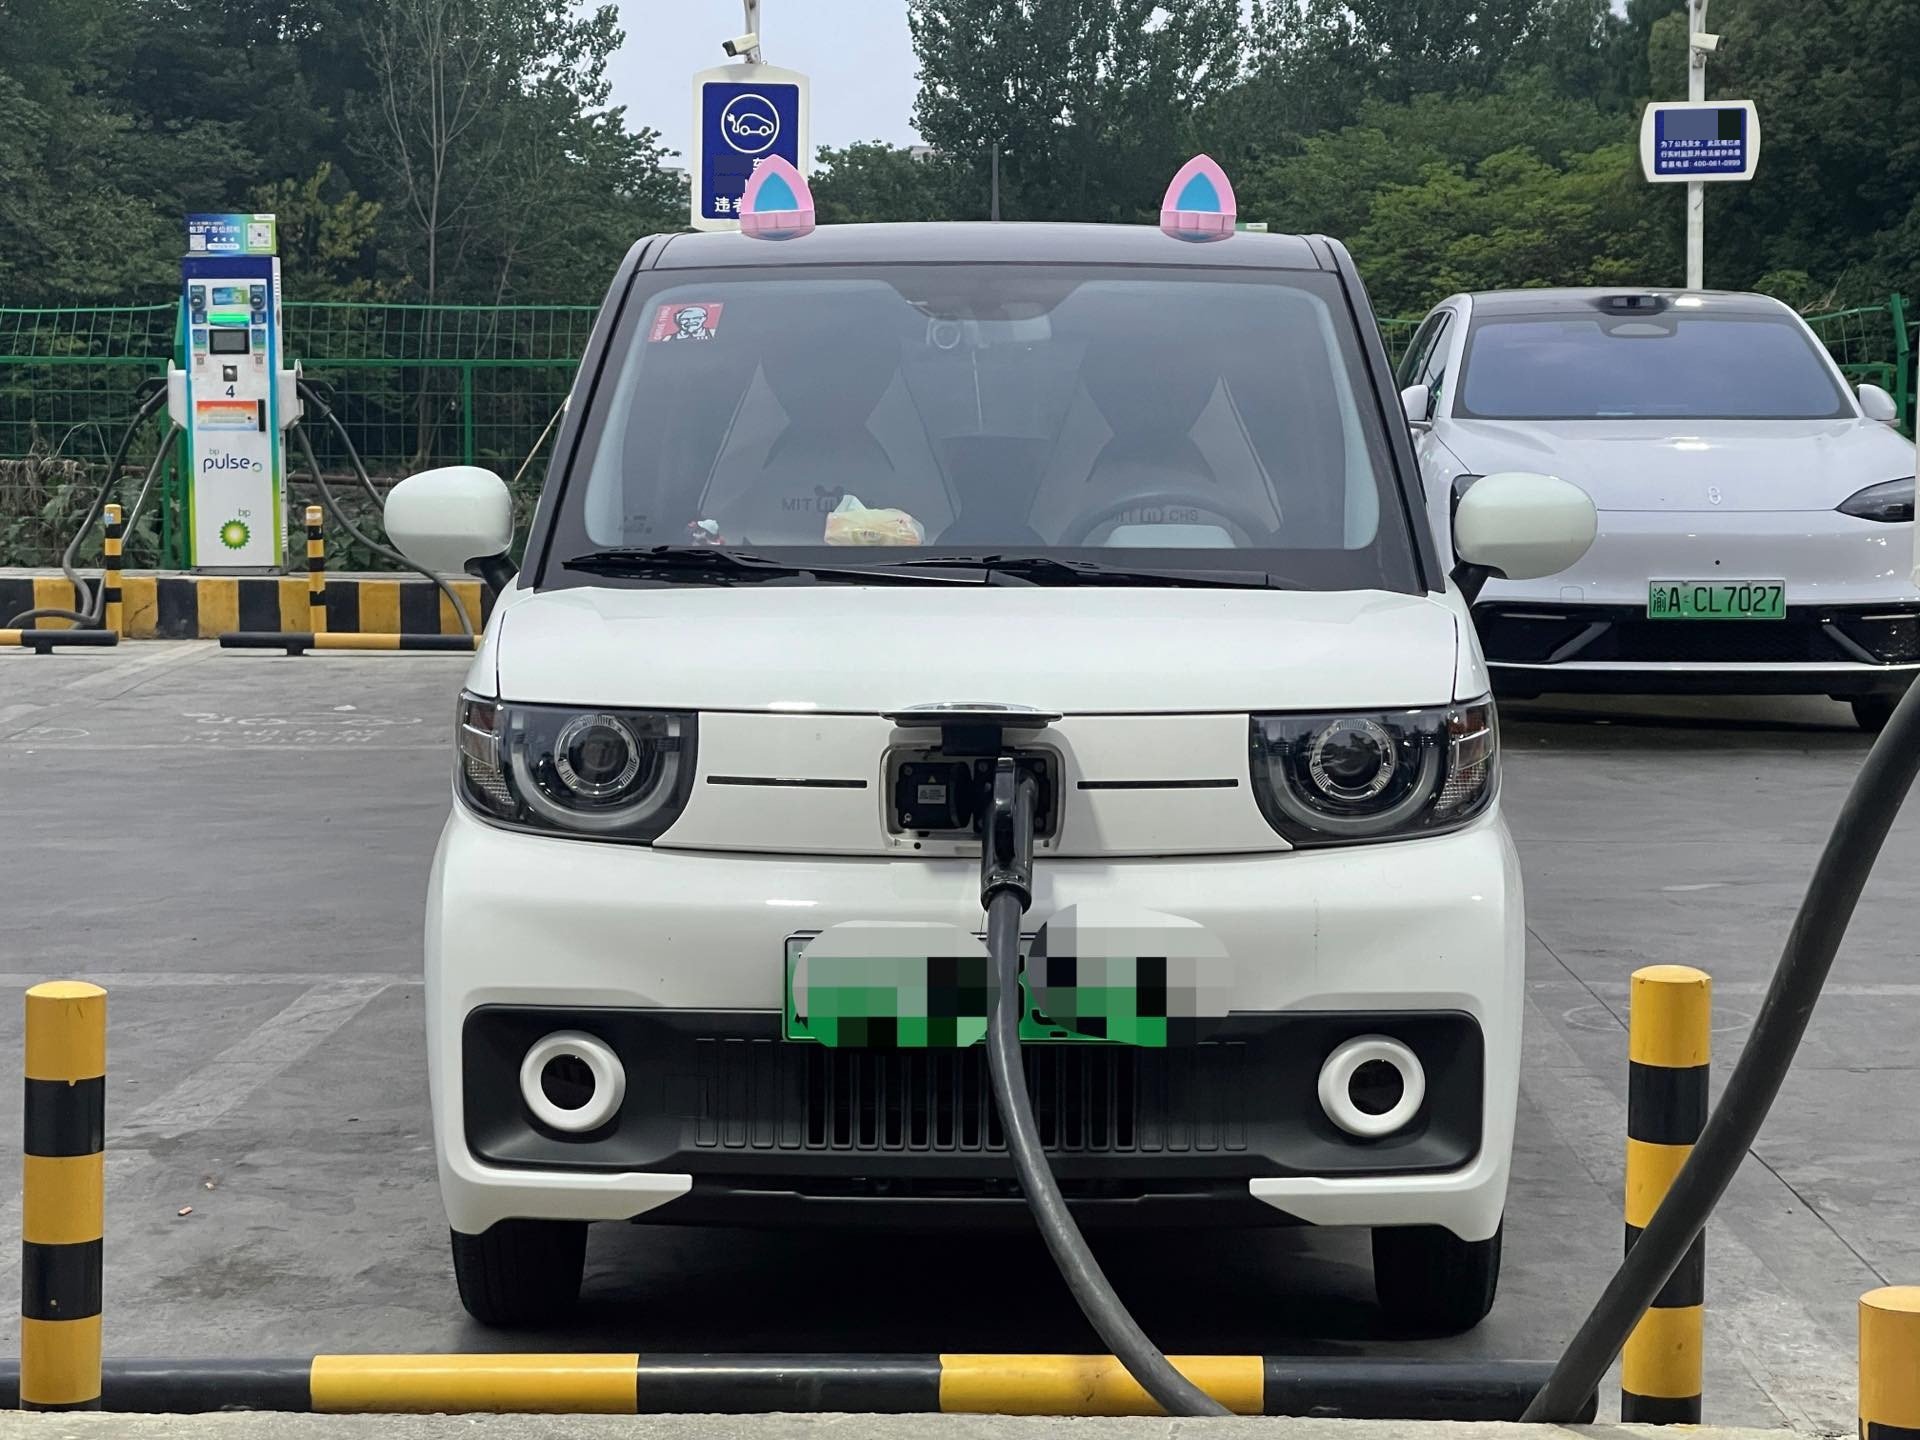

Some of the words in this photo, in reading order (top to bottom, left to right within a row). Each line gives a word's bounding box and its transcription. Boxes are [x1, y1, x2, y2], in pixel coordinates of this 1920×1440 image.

[225, 385, 236, 398] 4
[209, 447, 220, 456] bp
[203, 453, 251, 473] pulse
[238, 507, 251, 518] bp
[1694, 586, 1782, 613] CL7027
